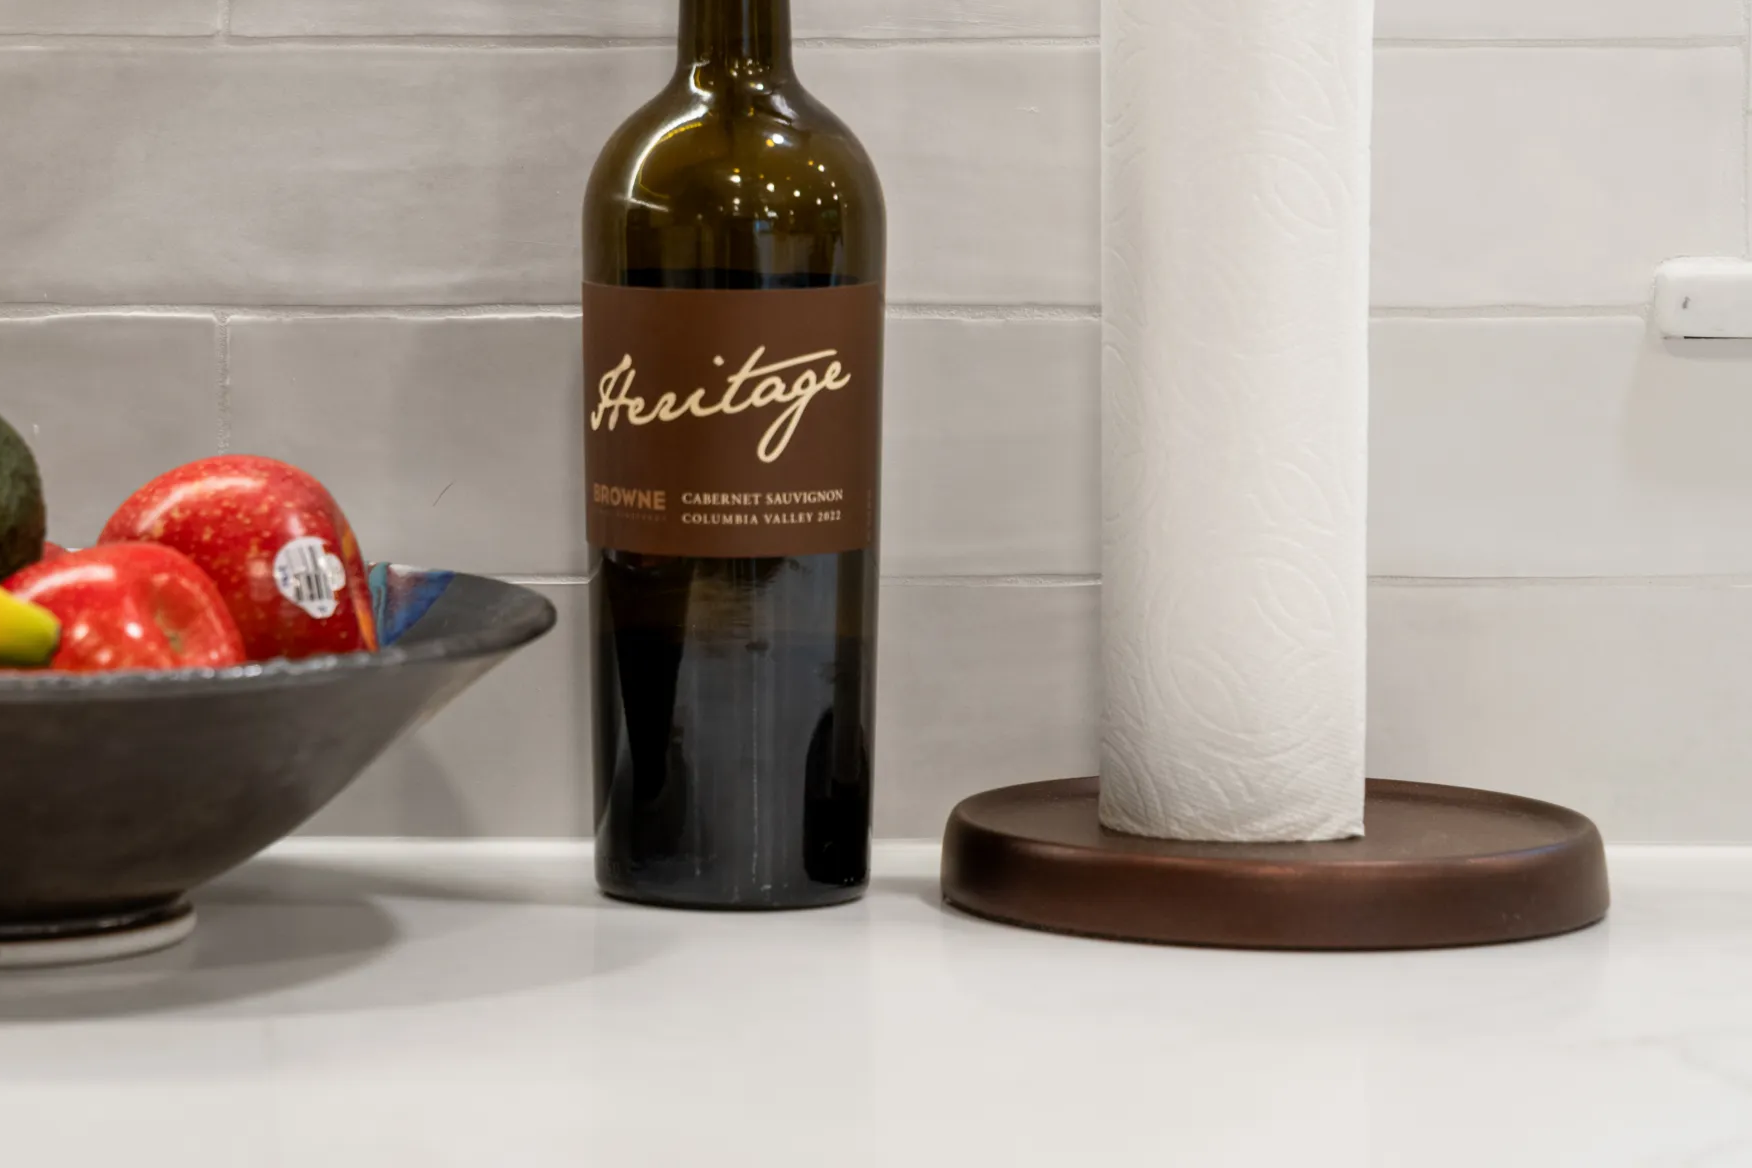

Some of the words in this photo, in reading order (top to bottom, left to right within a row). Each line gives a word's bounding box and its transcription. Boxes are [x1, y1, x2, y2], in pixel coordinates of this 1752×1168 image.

[590, 345, 851, 463] Heritage
[593, 482, 666, 511] BROWNE
[681, 492, 762, 506] CABERNET
[766, 488, 844, 505] SAUVIGNON
[681, 513, 759, 525] COLUMBIA
[763, 512, 814, 525] VALLEY
